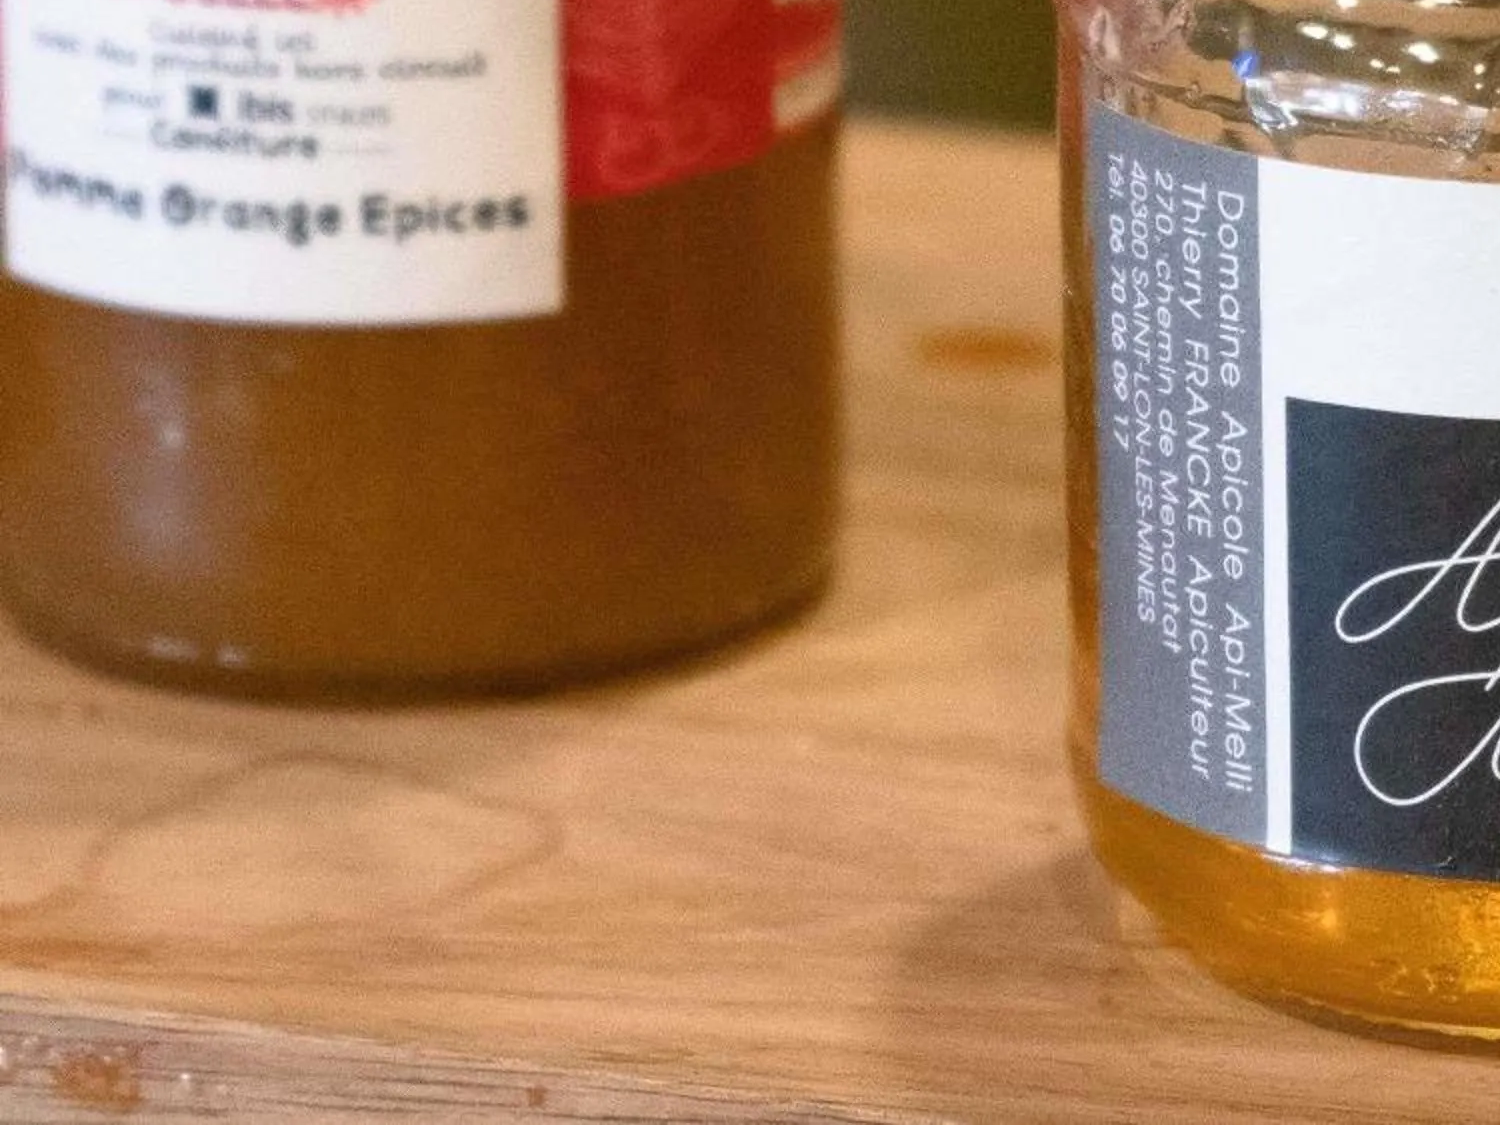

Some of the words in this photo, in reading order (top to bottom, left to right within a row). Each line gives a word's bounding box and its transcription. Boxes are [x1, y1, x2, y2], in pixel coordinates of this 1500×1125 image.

[160, 182, 342, 247] Orange
[359, 191, 530, 245] Epices
[1108, 213, 1126, 253] 06
[1129, 159, 1149, 261] 40300
[1178, 181, 1207, 321] Thierry
[1110, 265, 1127, 305] 70
[1111, 310, 1128, 352] 06
[1155, 259, 1176, 395] chemin
[1216, 190, 1246, 388] Domaine
[1112, 414, 1130, 453] 17
[1131, 266, 1156, 623] SAINT-LON-LES-MINES
[1158, 408, 1178, 457] de
[1184, 338, 1212, 539] FRANCKE
[1215, 410, 1249, 580] Apicole
[1159, 469, 1182, 654] Menautat
[1184, 554, 1213, 780] Apiculteur
[1218, 602, 1252, 792] Api-Melli
